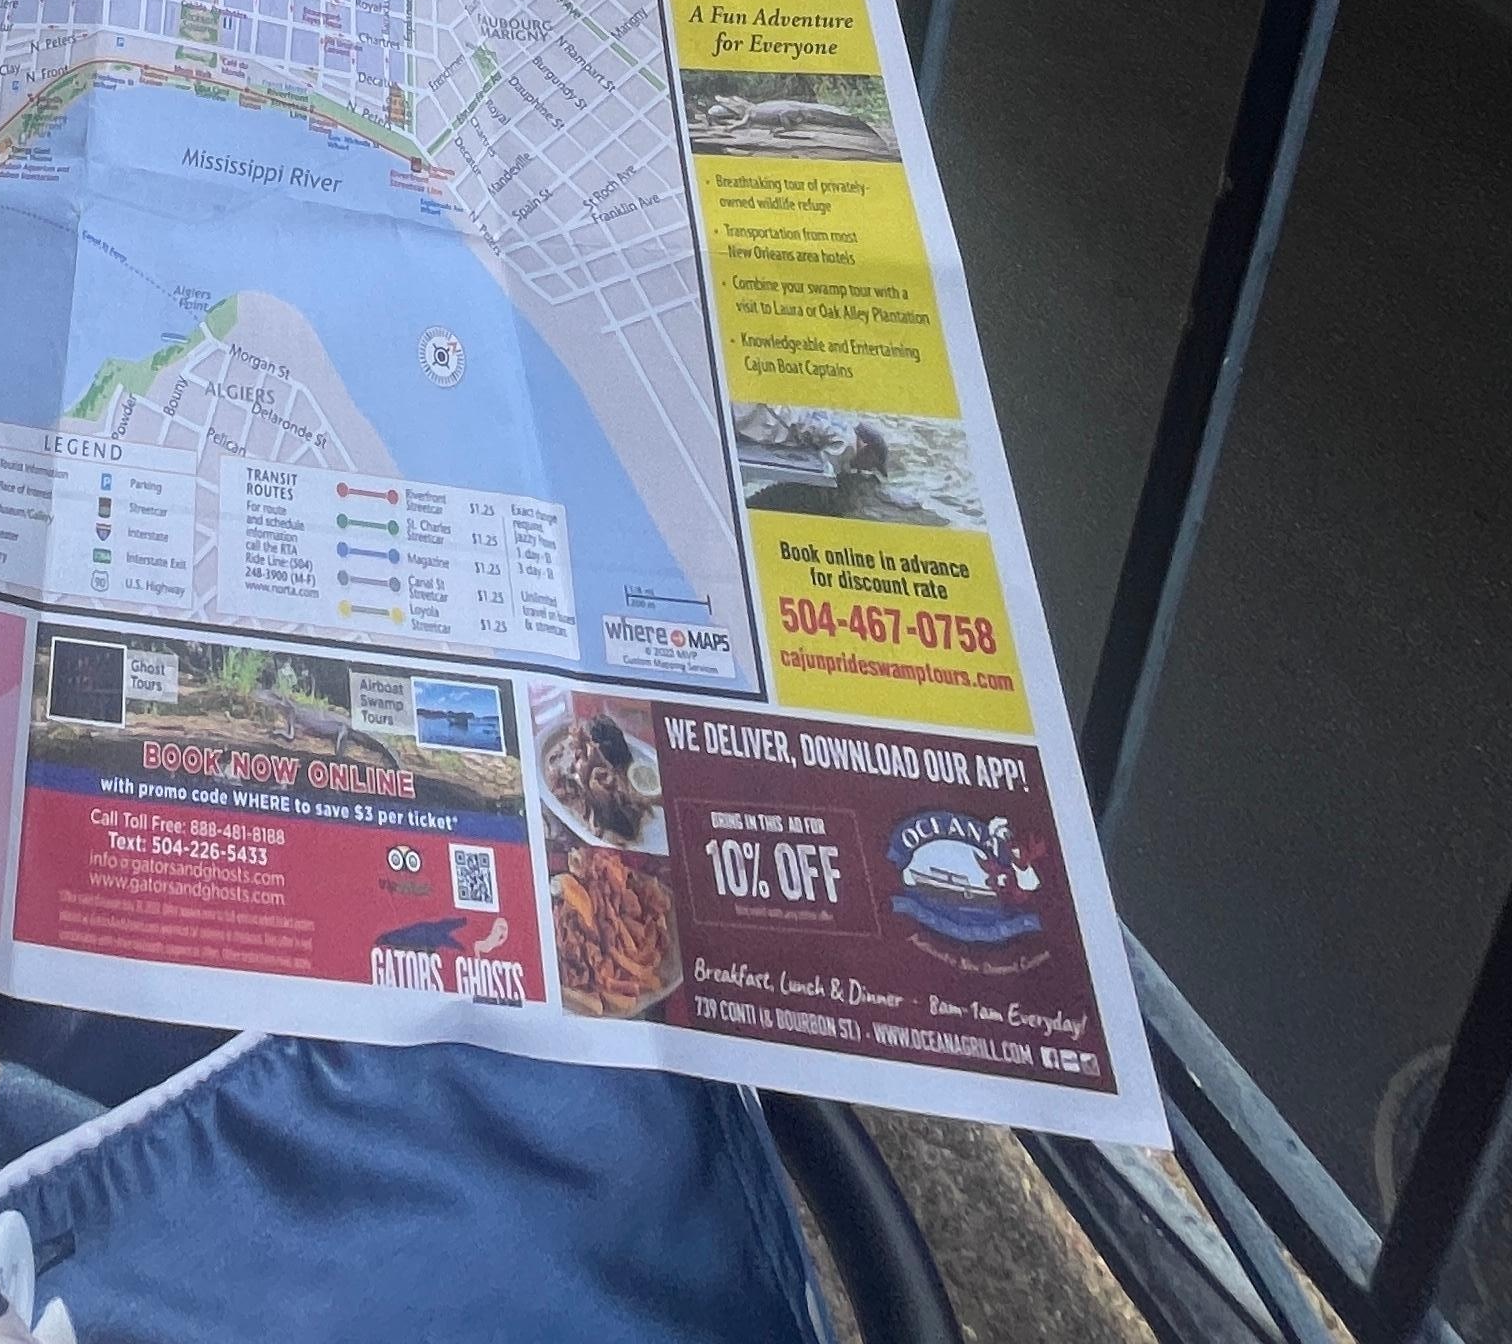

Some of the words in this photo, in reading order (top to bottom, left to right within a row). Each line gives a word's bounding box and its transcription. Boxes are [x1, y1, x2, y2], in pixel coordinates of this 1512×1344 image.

[688, 5, 703, 24] A
[710, 6, 747, 25] Fun
[753, 8, 854, 29] Adventure
[712, 31, 743, 57] for
[749, 35, 838, 60] Everyone
[182, 147, 284, 183] Mississippi
[289, 167, 343, 193] River
[205, 381, 276, 405] ALGIERS
[44, 434, 123, 461] LEGEND
[246, 466, 298, 487] TRANSIT
[246, 483, 295, 501] ROUTES
[780, 540, 819, 562] Book
[825, 547, 876, 569] online
[880, 551, 895, 572] in
[901, 555, 970, 579] advance
[810, 567, 833, 587] for
[838, 571, 910, 597] discount
[914, 581, 948, 600] rate
[604, 615, 668, 645] where
[688, 624, 730, 653] MAPS
[779, 597, 997, 656] 504-467-0758
[130, 658, 167, 679] Ghost
[130, 675, 163, 693] Tours
[780, 647, 1015, 693] cajunprideswamptours.com
[359, 677, 405, 696] Airboat
[360, 693, 404, 712] Swamp
[360, 711, 394, 727] Tours
[142, 740, 221, 775] BOOK
[230, 751, 300, 786] NOW
[307, 763, 416, 800] ONLINE
[663, 716, 701, 753] WE
[704, 720, 797, 769] DELIVER,
[800, 733, 921, 782] DOWNLOAD
[924, 748, 972, 787] OUR
[976, 755, 1030, 794] APP!
[100, 776, 134, 795] with
[139, 780, 187, 802] promo
[191, 785, 228, 805] code
[232, 789, 292, 813] WHERE
[295, 798, 311, 815] to
[315, 803, 350, 819] save
[355, 805, 374, 823] $3
[378, 808, 403, 828] per
[107, 831, 147, 854] Text:
[151, 835, 269, 867] 504-226-5433
[705, 839, 770, 900] 10%
[774, 842, 842, 905] OFF
[370, 946, 444, 993] GATORS
[454, 956, 525, 1003] GHOSTS
